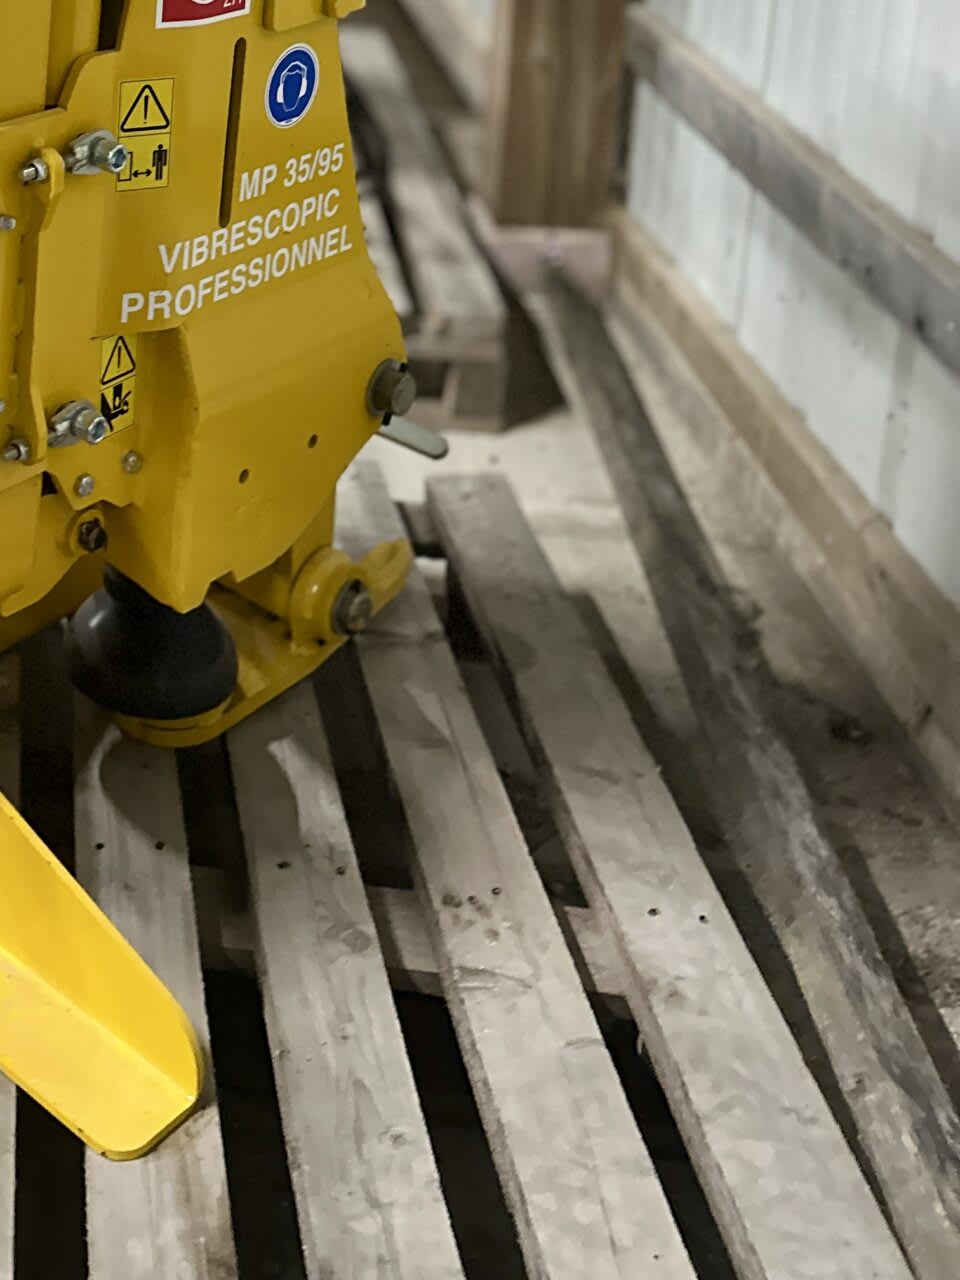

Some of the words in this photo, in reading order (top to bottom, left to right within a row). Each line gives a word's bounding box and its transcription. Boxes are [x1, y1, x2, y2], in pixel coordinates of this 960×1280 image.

[239, 164, 277, 202] MP
[283, 143, 345, 188] 35/95
[120, 225, 353, 323] PROFESSIONNEL
[158, 188, 340, 274] VIBRESCOPIC
